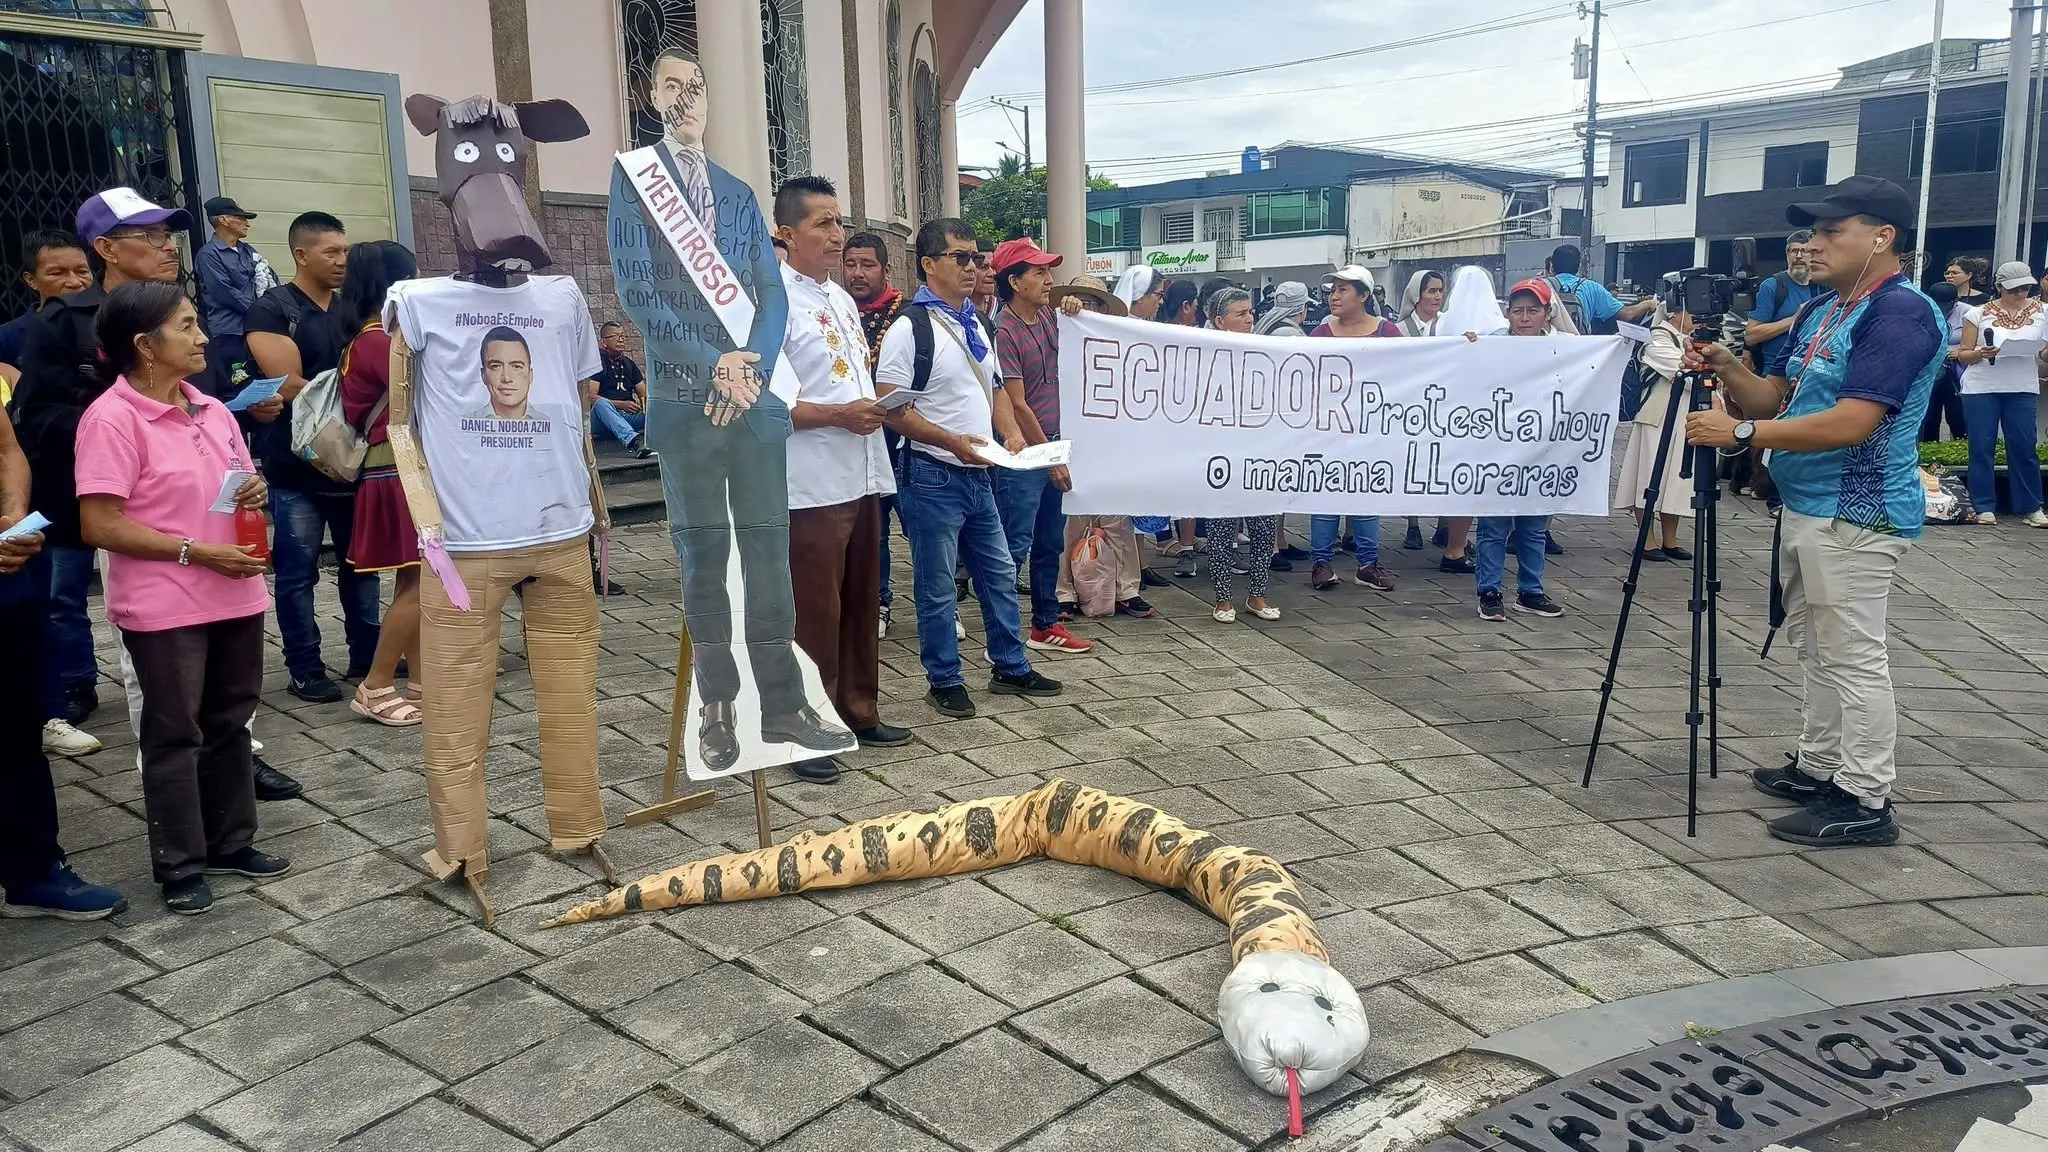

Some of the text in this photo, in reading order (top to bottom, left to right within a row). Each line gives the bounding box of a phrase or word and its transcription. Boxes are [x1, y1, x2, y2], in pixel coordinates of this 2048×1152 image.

[637, 162, 738, 305] MENTIROSO
[1146, 248, 1210, 267] Tatiana Arias
[626, 289, 689, 311] COMPRA
[455, 312, 545, 329] #NoboaEsEmpleo
[707, 364, 735, 382] DEL
[1082, 336, 1611, 462] ECUADOR Protesta hoy
[461, 419, 551, 433] DANIEL NOBOA AZIN
[480, 436, 534, 449] PRESIDENTE
[1206, 455, 1231, 490] o
[1243, 454, 1394, 495] mañana
